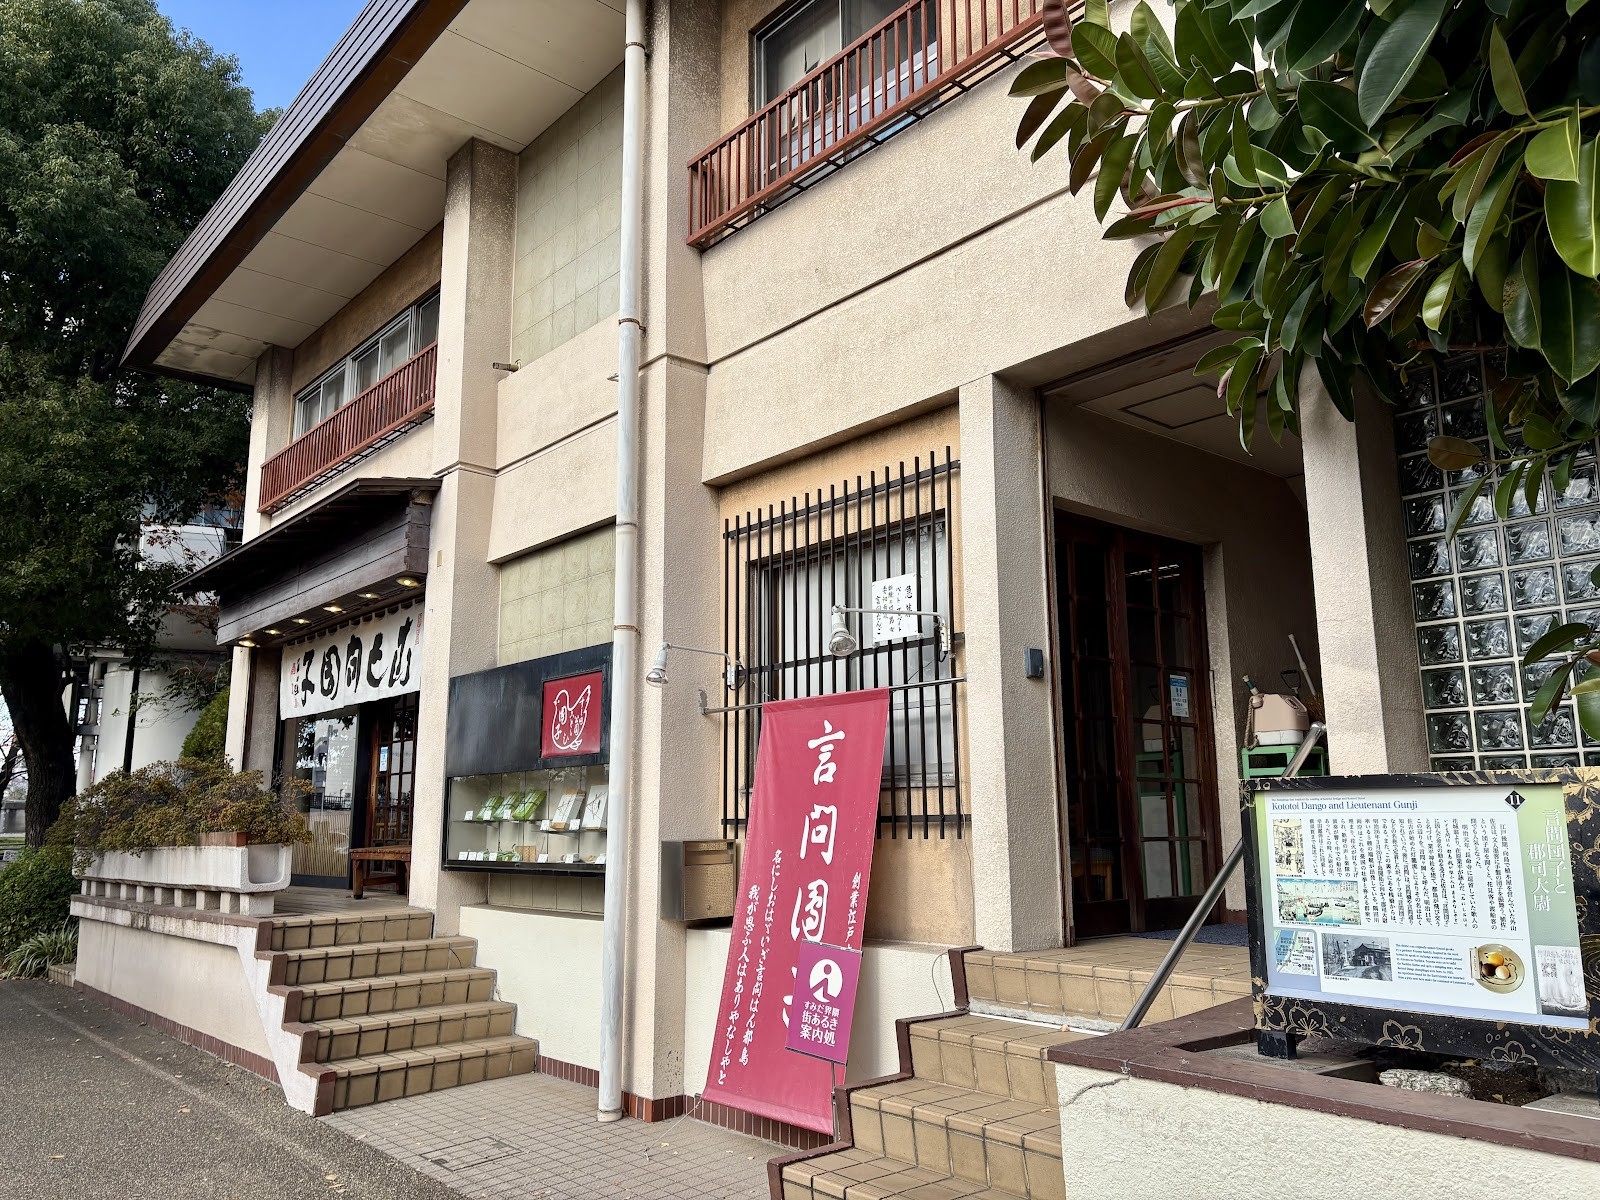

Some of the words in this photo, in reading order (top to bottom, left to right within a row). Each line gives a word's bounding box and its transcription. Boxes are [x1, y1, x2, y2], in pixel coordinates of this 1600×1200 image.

[1272, 802, 1300, 810] Kototoi
[1301, 802, 1326, 811] Dango
[1328, 801, 1344, 810] and
[1346, 801, 1391, 810] Lieutenant
[1393, 800, 1418, 810] Gunji
[1510, 794, 1521, 805] 11
[1528, 843, 1551, 912] 郡司大尉
[845, 871, 862, 949] 創業江戸
[802, 1010, 838, 1031] 街あるき
[800, 1024, 836, 1047] 案内処
